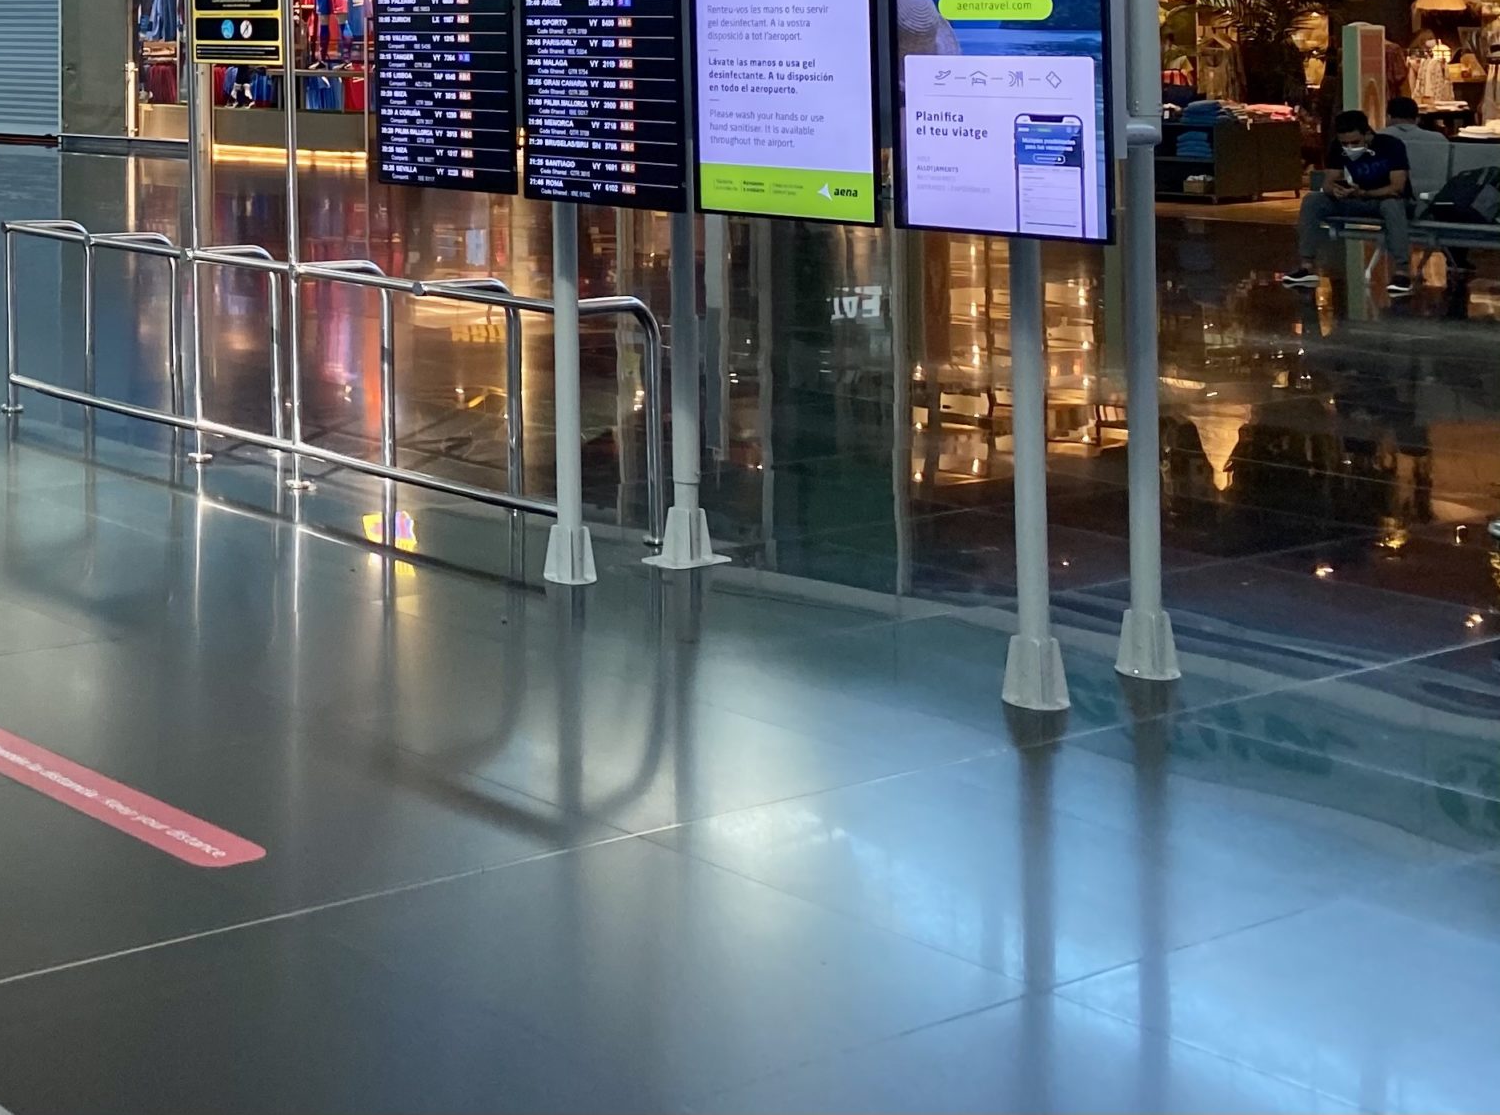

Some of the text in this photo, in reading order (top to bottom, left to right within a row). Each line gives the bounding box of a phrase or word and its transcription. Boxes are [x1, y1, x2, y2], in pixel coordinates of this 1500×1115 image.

[956, 0, 1032, 11] aenatravel.com
[708, 58, 734, 66] Lávate
[736, 58, 748, 66] las
[802, 59, 816, 69] gel
[768, 72, 774, 80] A
[777, 72, 785, 80] tu
[916, 111, 964, 123] Planifica
[916, 126, 988, 139] el teu viatge
[834, 187, 858, 198] aena
[165, 829, 226, 858] distance
